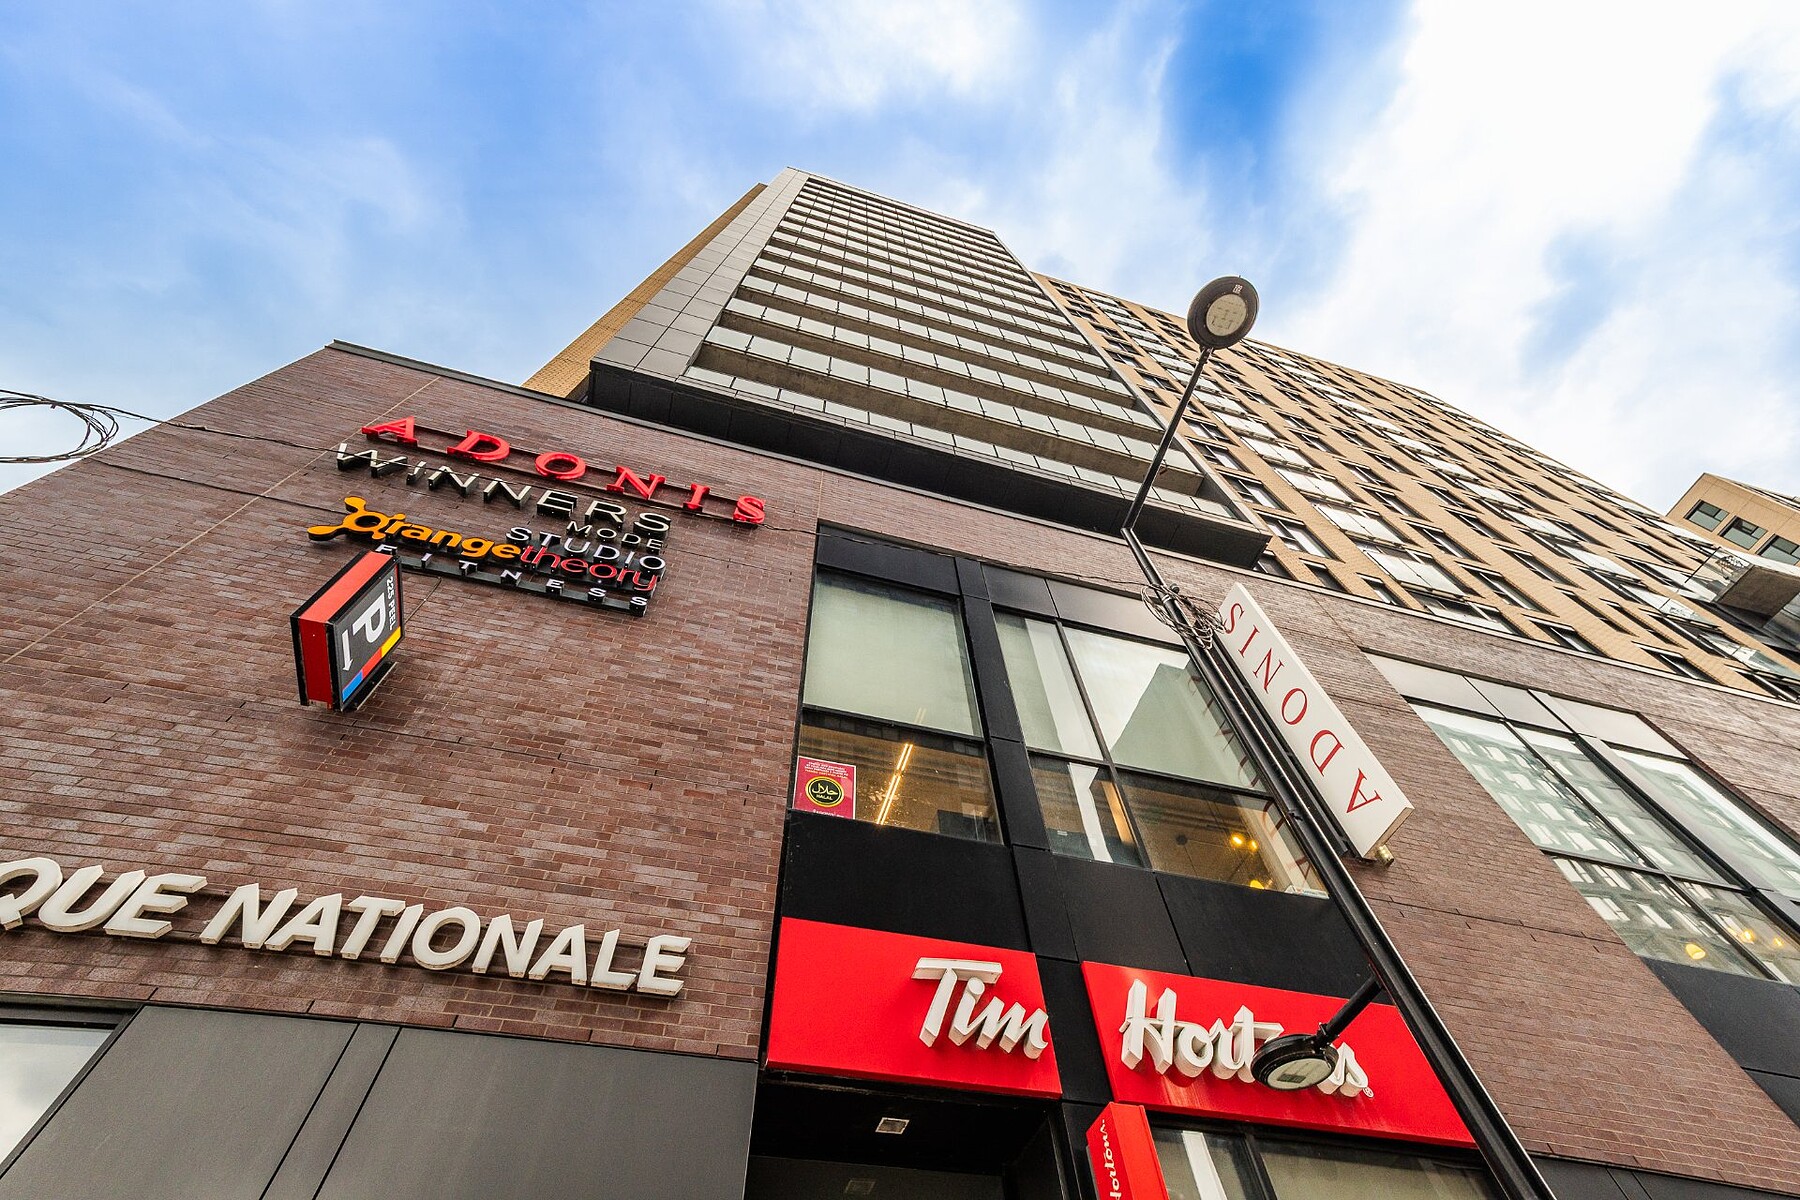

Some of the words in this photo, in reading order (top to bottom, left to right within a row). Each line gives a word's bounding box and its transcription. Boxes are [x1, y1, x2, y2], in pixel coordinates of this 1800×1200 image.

[337, 443, 672, 535] WINNERS
[362, 416, 765, 524] ADONIS
[506, 526, 667, 571] STUDIO
[566, 520, 664, 550] MODE
[374, 543, 648, 606] FITNESS
[386, 576, 395, 599] 225
[353, 592, 387, 643] P
[388, 601, 397, 631] PEEL
[1224, 602, 1383, 814] ADONIS
[200, 883, 692, 996] NATIONALE
[911, 957, 1049, 1060] Tim
[1119, 978, 1370, 1098] Horts
